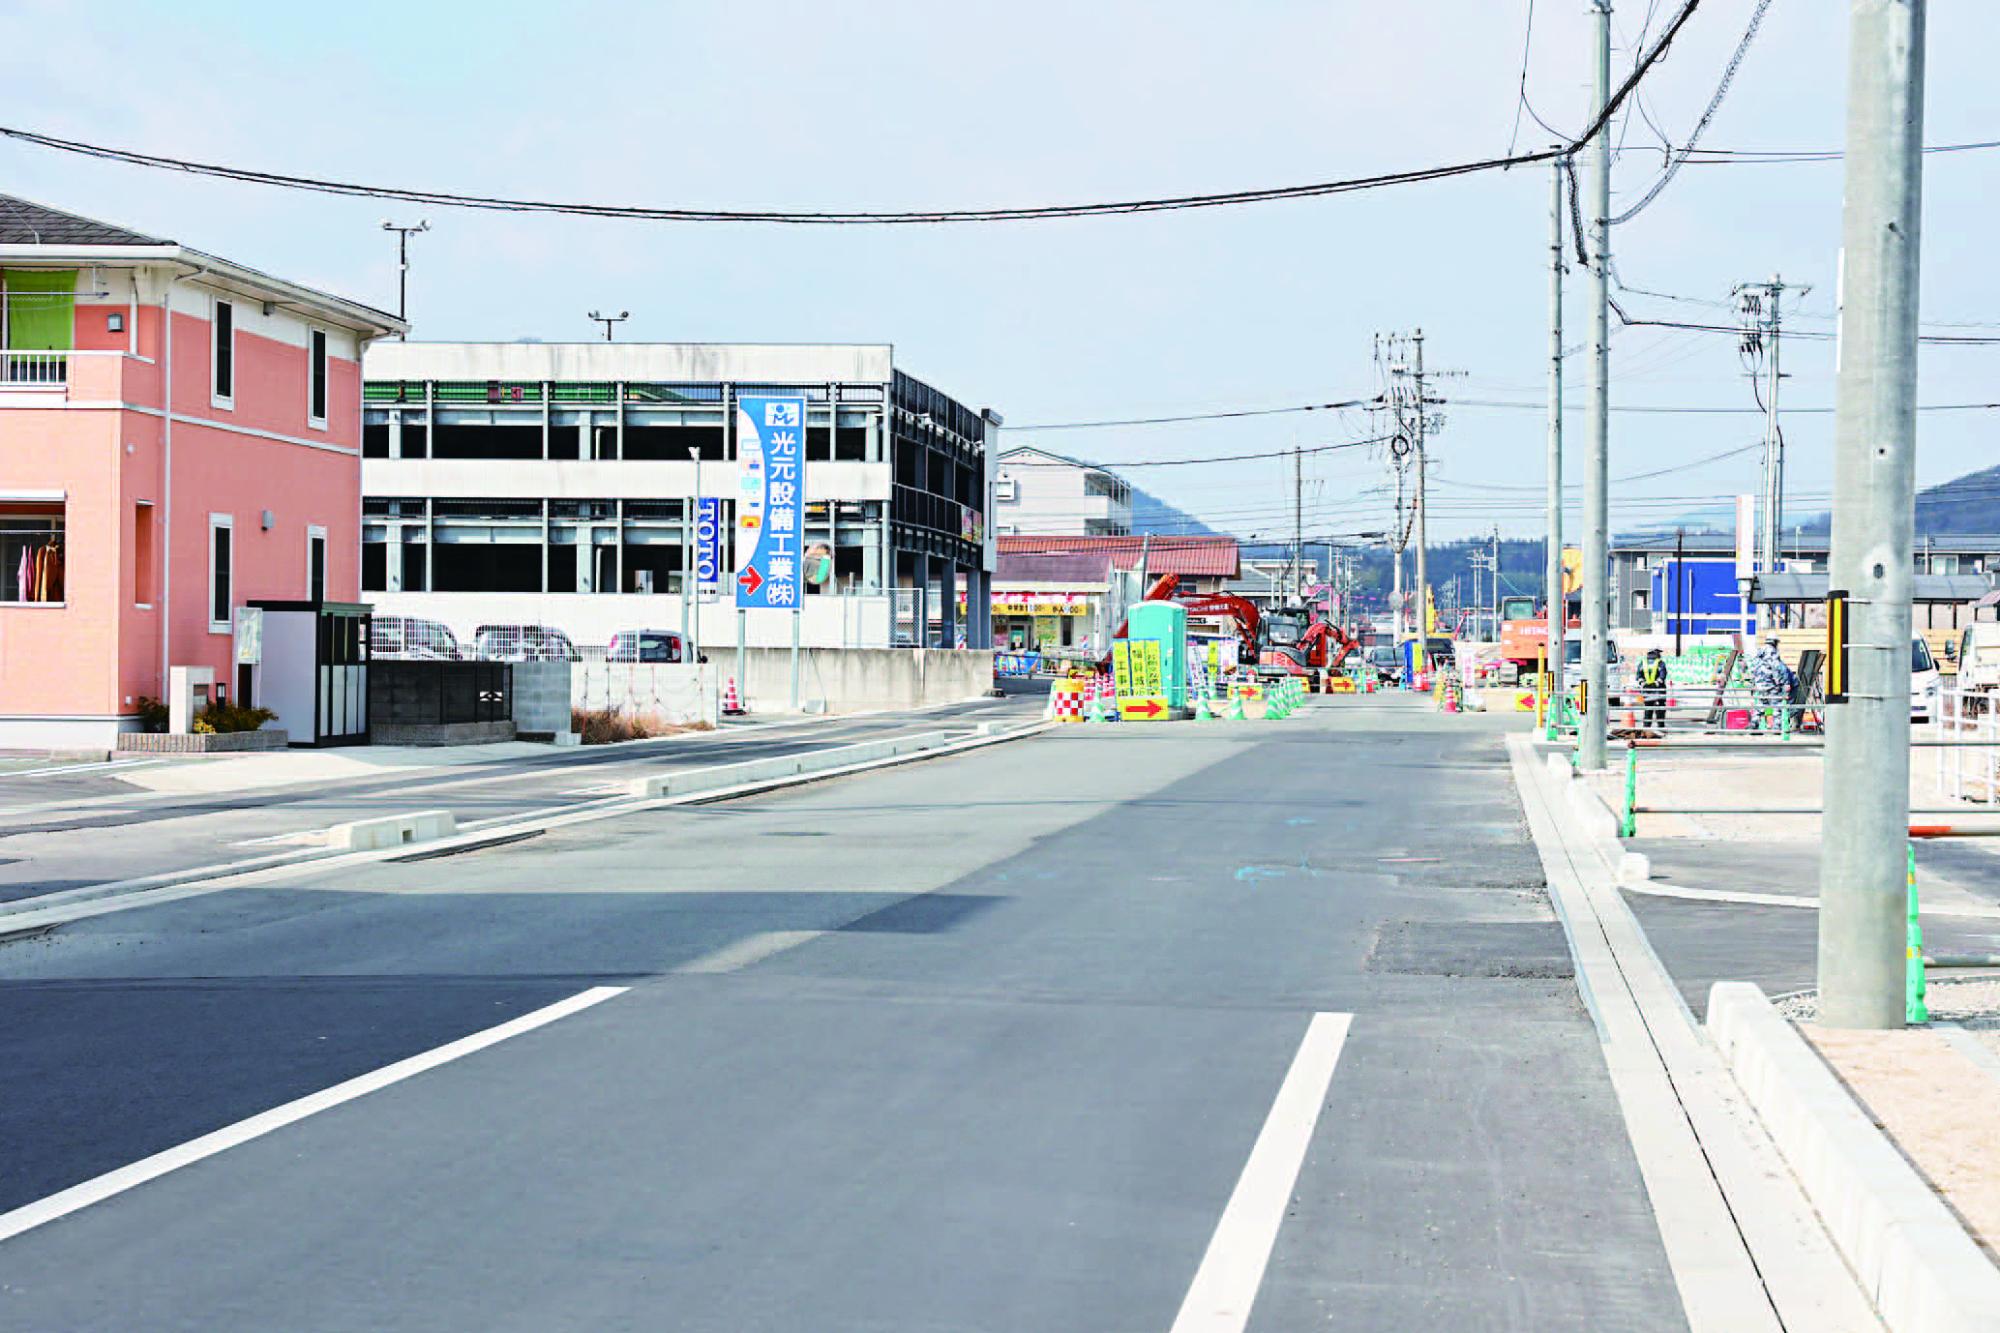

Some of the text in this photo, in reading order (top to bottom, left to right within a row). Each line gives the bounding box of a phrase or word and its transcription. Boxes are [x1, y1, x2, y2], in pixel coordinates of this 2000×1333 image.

[698, 502, 715, 580] TOTO
[767, 431, 797, 605] 光元設備工業(株)
